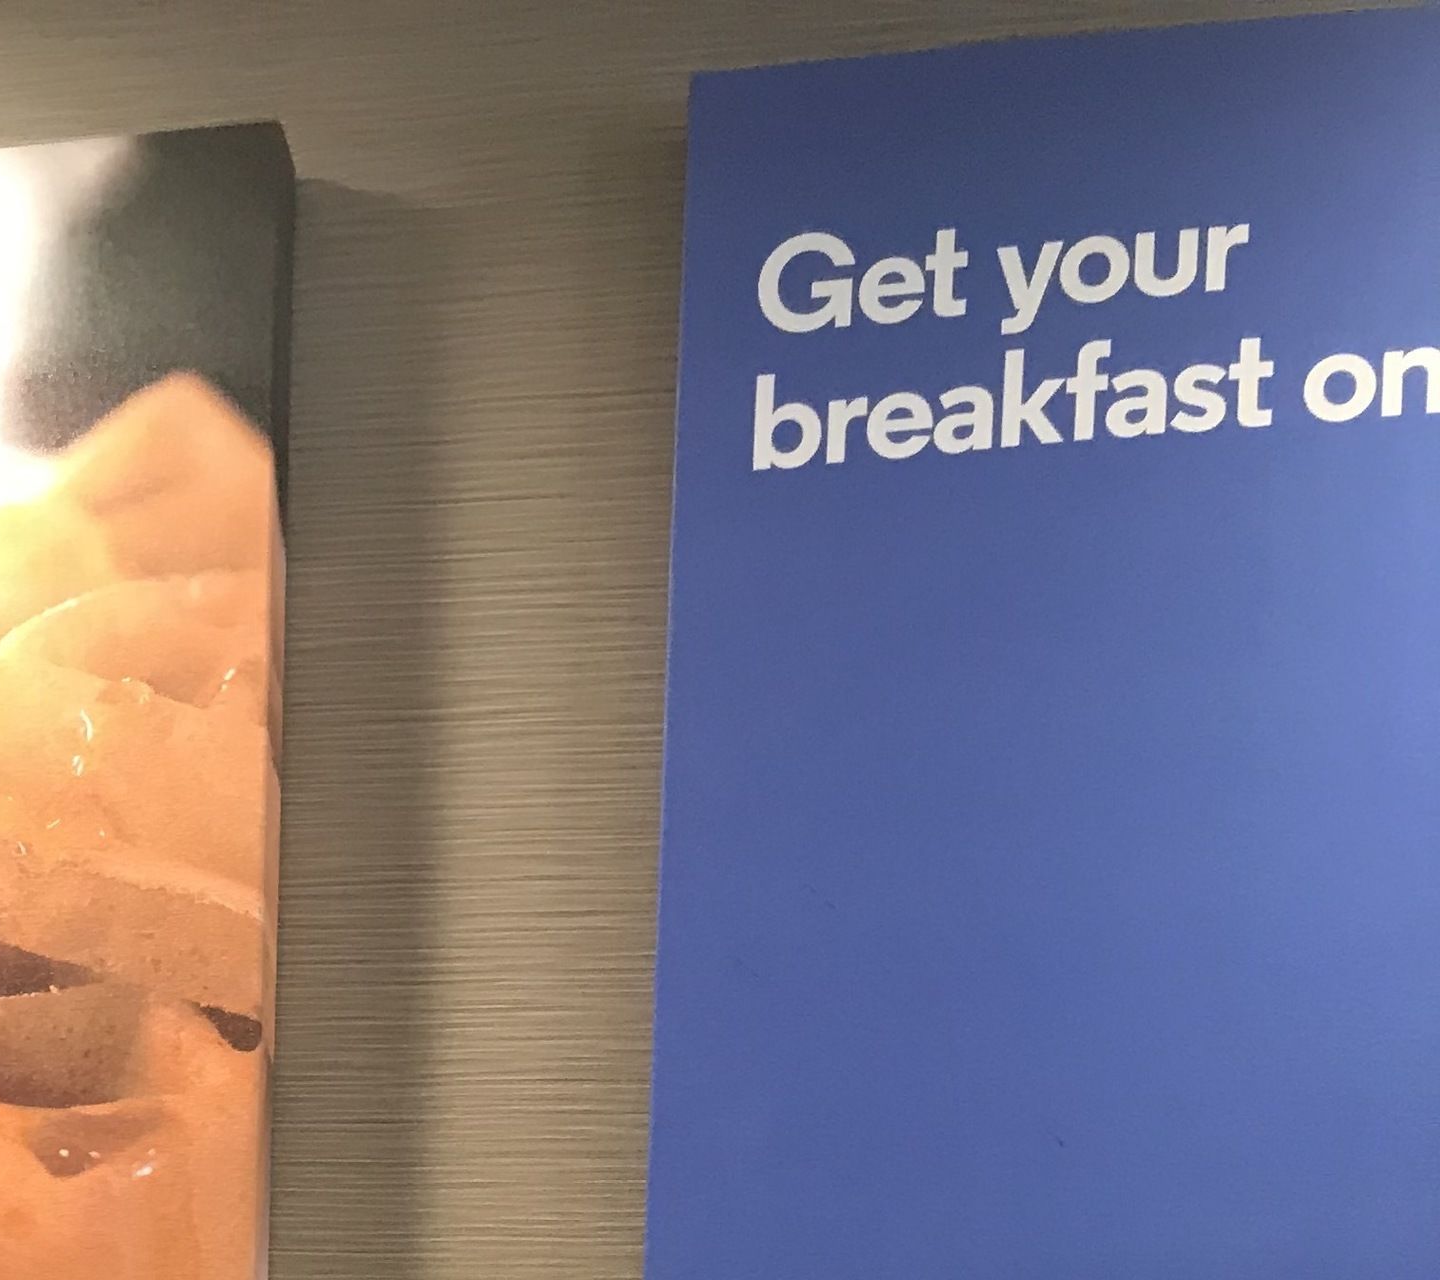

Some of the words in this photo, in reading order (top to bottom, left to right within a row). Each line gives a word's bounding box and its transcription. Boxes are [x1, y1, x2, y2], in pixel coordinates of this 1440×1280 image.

[757, 227, 969, 334] Get
[996, 223, 1251, 336] your
[752, 336, 1275, 471] breakfast
[1303, 346, 1440, 424] on
